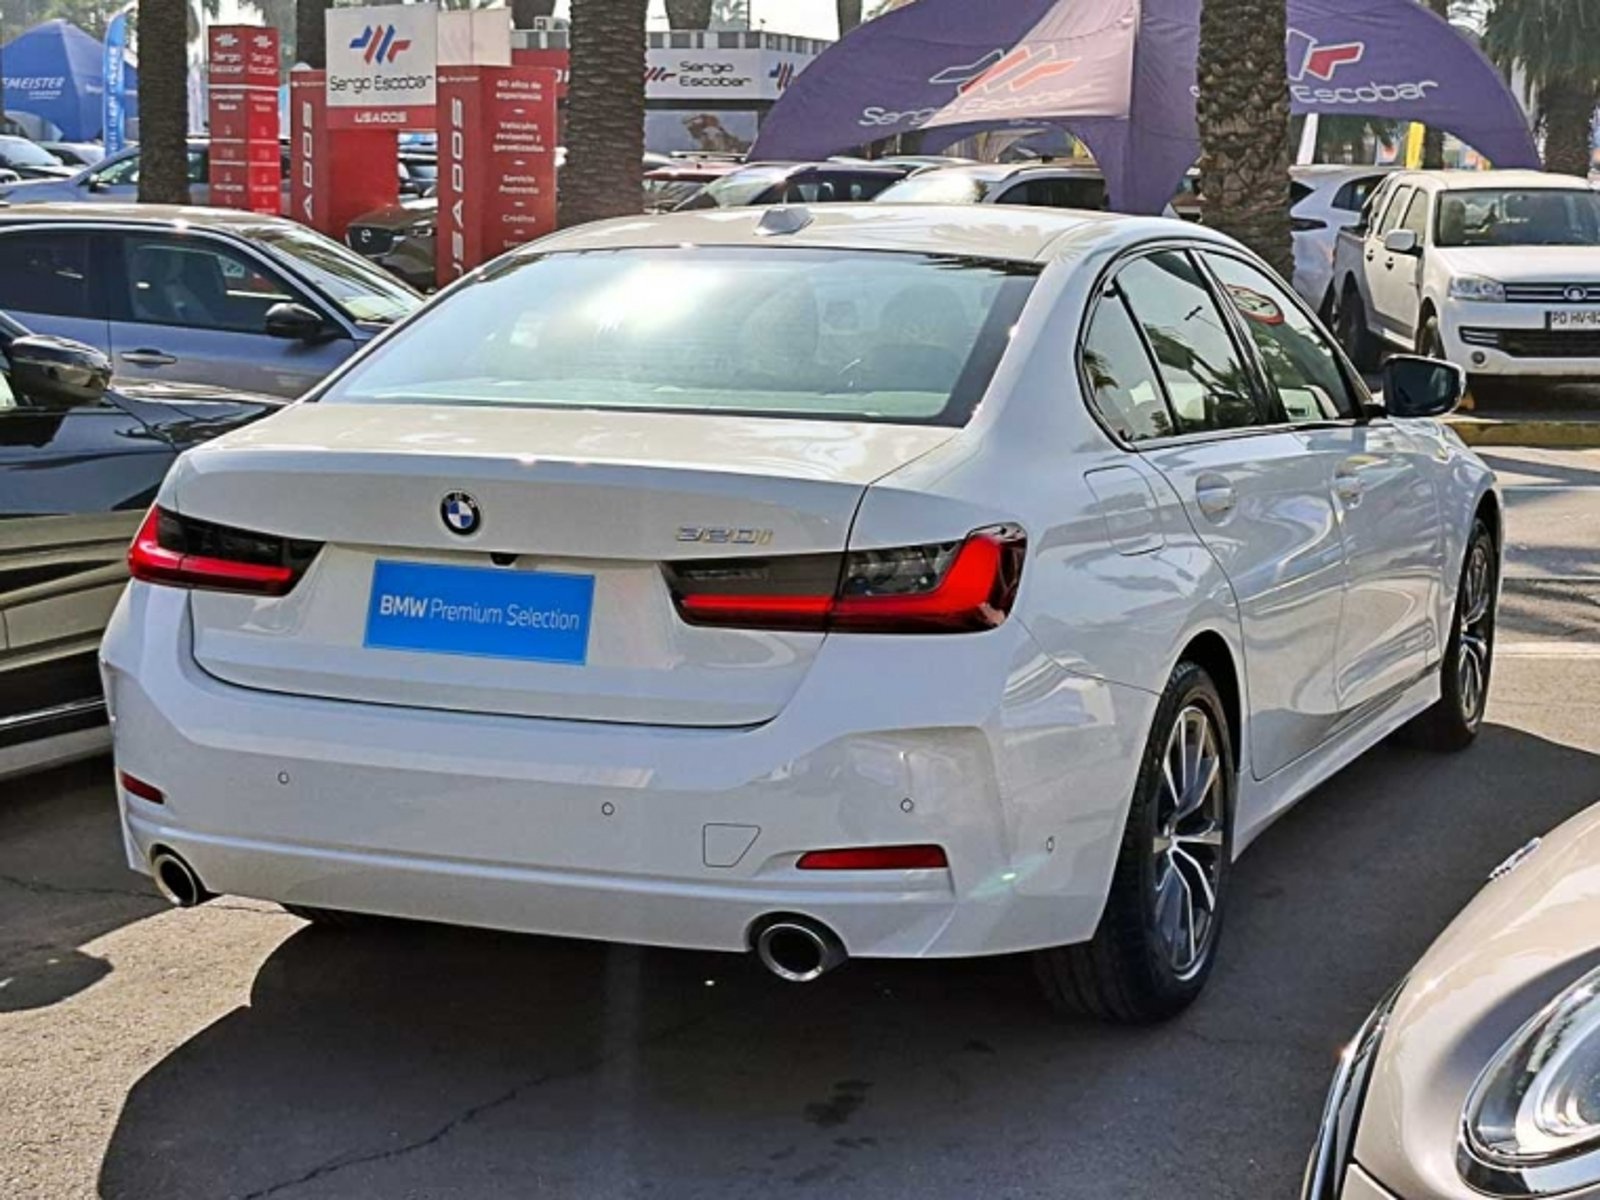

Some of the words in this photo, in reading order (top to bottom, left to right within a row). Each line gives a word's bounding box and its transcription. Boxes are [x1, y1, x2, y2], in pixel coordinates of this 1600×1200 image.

[374, 74, 433, 91] Escobar
[679, 75, 752, 88] Escobar
[1290, 80, 1439, 104] Escobar
[354, 111, 408, 123] USADOS
[302, 101, 314, 221] ADOS
[379, 595, 428, 618] BMW
[429, 598, 502, 624] Premium
[506, 604, 580, 630] Selection
